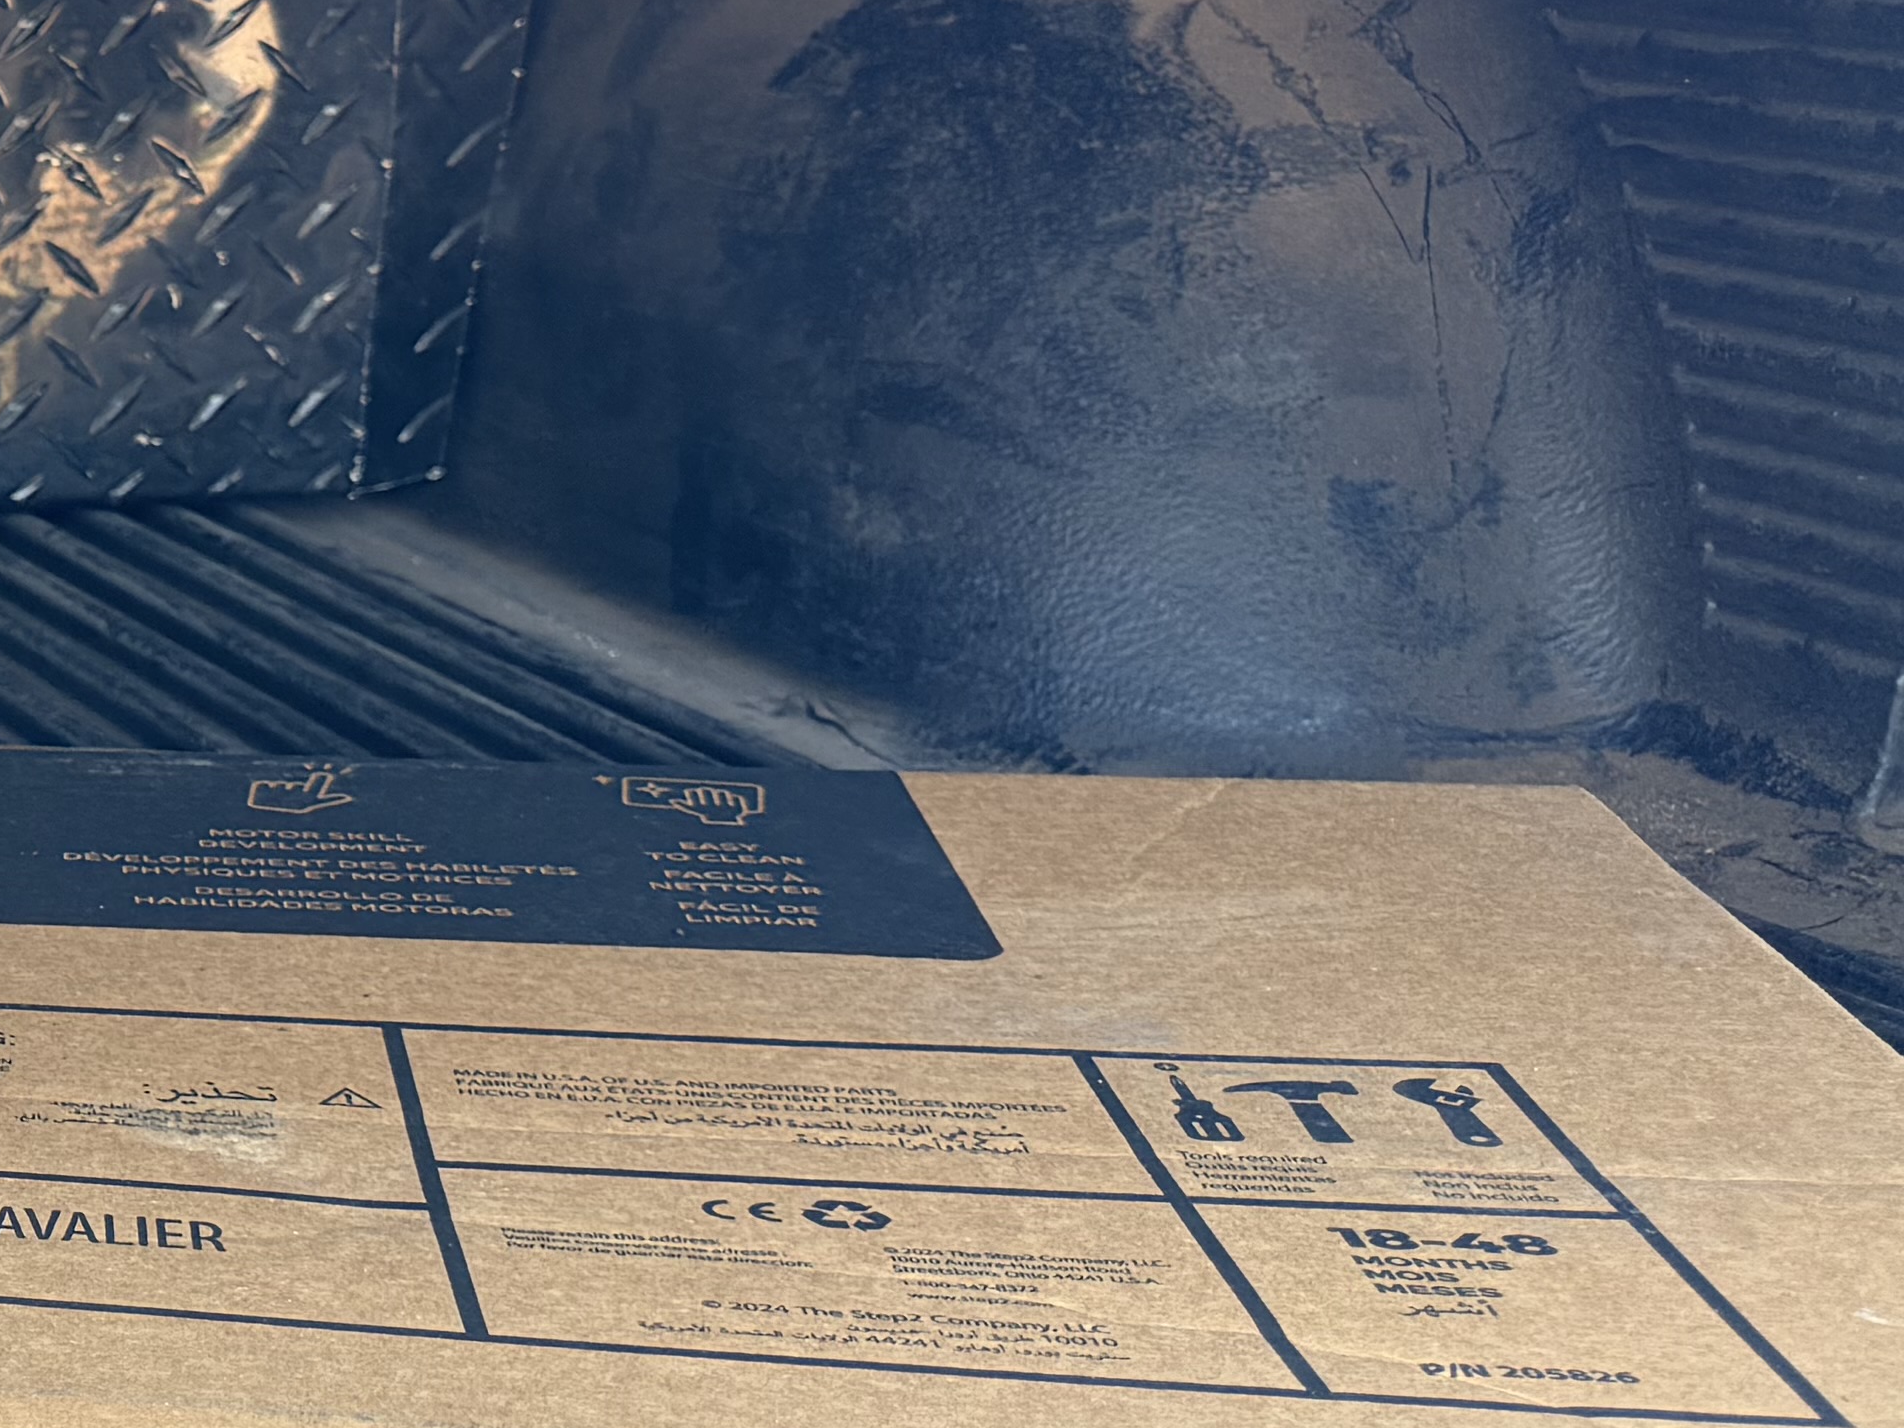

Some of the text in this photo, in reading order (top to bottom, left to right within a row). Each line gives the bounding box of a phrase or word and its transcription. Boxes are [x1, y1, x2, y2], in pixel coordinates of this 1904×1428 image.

[210, 829, 414, 842] MOTOR SKILL
[199, 840, 426, 853] DEVELOPMENT
[679, 842, 760, 852] EASY
[644, 852, 806, 865] TO CLEAN
[339, 861, 396, 870] DES
[122, 866, 512, 885] PHYSIQUES ET MOTRICES
[664, 870, 773, 882] FACILE
[195, 887, 454, 903] DESARROLLO DE
[649, 882, 822, 895] NETTOYER
[134, 896, 513, 916] HABILIDADES MOTORAS
[778, 905, 820, 914] DE
[685, 914, 817, 927] LIMPIAR
[453, 1069, 512, 1078] MADE
[543, 1074, 597, 1083] U.S.A.
[602, 1076, 628, 1084] OF
[676, 1080, 719, 1089] AND
[725, 1083, 829, 1093] IMPORTED
[834, 1087, 896, 1096] PARTS
[561, 1084, 601, 1093] AUX
[835, 1097, 874, 1105] DES
[458, 1089, 530, 1098] HECHO
[627, 1097, 670, 1106] CON
[678, 1099, 747, 1109] PIEZAS
[752, 1103, 778, 1111] DE
[861, 1108, 997, 1119] IMPORTADAS
[1176, 1150, 1327, 1164] Tools required
[1327, 1227, 1559, 1255] 18-48
[1351, 1255, 1514, 1271] MONTHS
[1363, 1269, 1460, 1282] MOIS
[1373, 1284, 1503, 1298] MESES
[729, 1303, 788, 1313] 2024
[798, 1307, 842, 1317] The
[851, 1311, 921, 1322] Step2
[1064, 1324, 1111, 1334] LLC
[865, 1337, 940, 1348] 44241
[1041, 1335, 1118, 1347] 10010
[1419, 1363, 1640, 1384] P/N 205826
